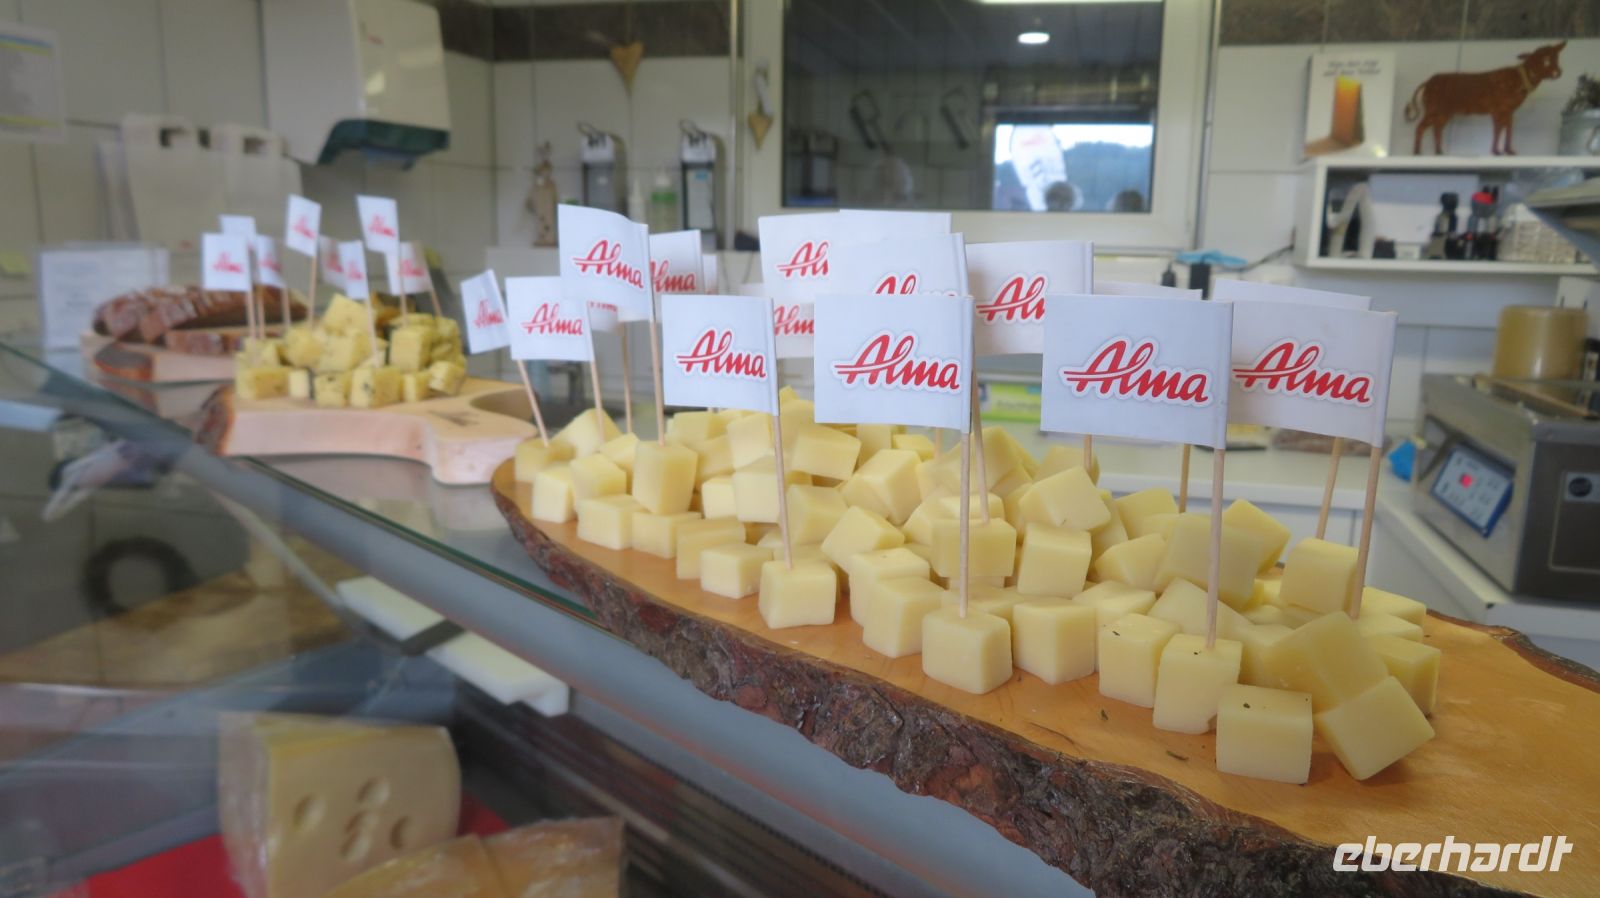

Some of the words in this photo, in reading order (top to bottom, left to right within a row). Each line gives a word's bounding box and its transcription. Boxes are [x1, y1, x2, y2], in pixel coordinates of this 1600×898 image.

[573, 240, 643, 289] Alma
[777, 241, 829, 277] Al
[521, 303, 583, 335] Alma
[774, 304, 814, 337] Alm
[976, 276, 1046, 321] Al
[677, 329, 767, 378] Alma
[834, 334, 960, 390] Alma
[1063, 340, 1209, 403] Alma
[1232, 342, 1371, 404] Alma
